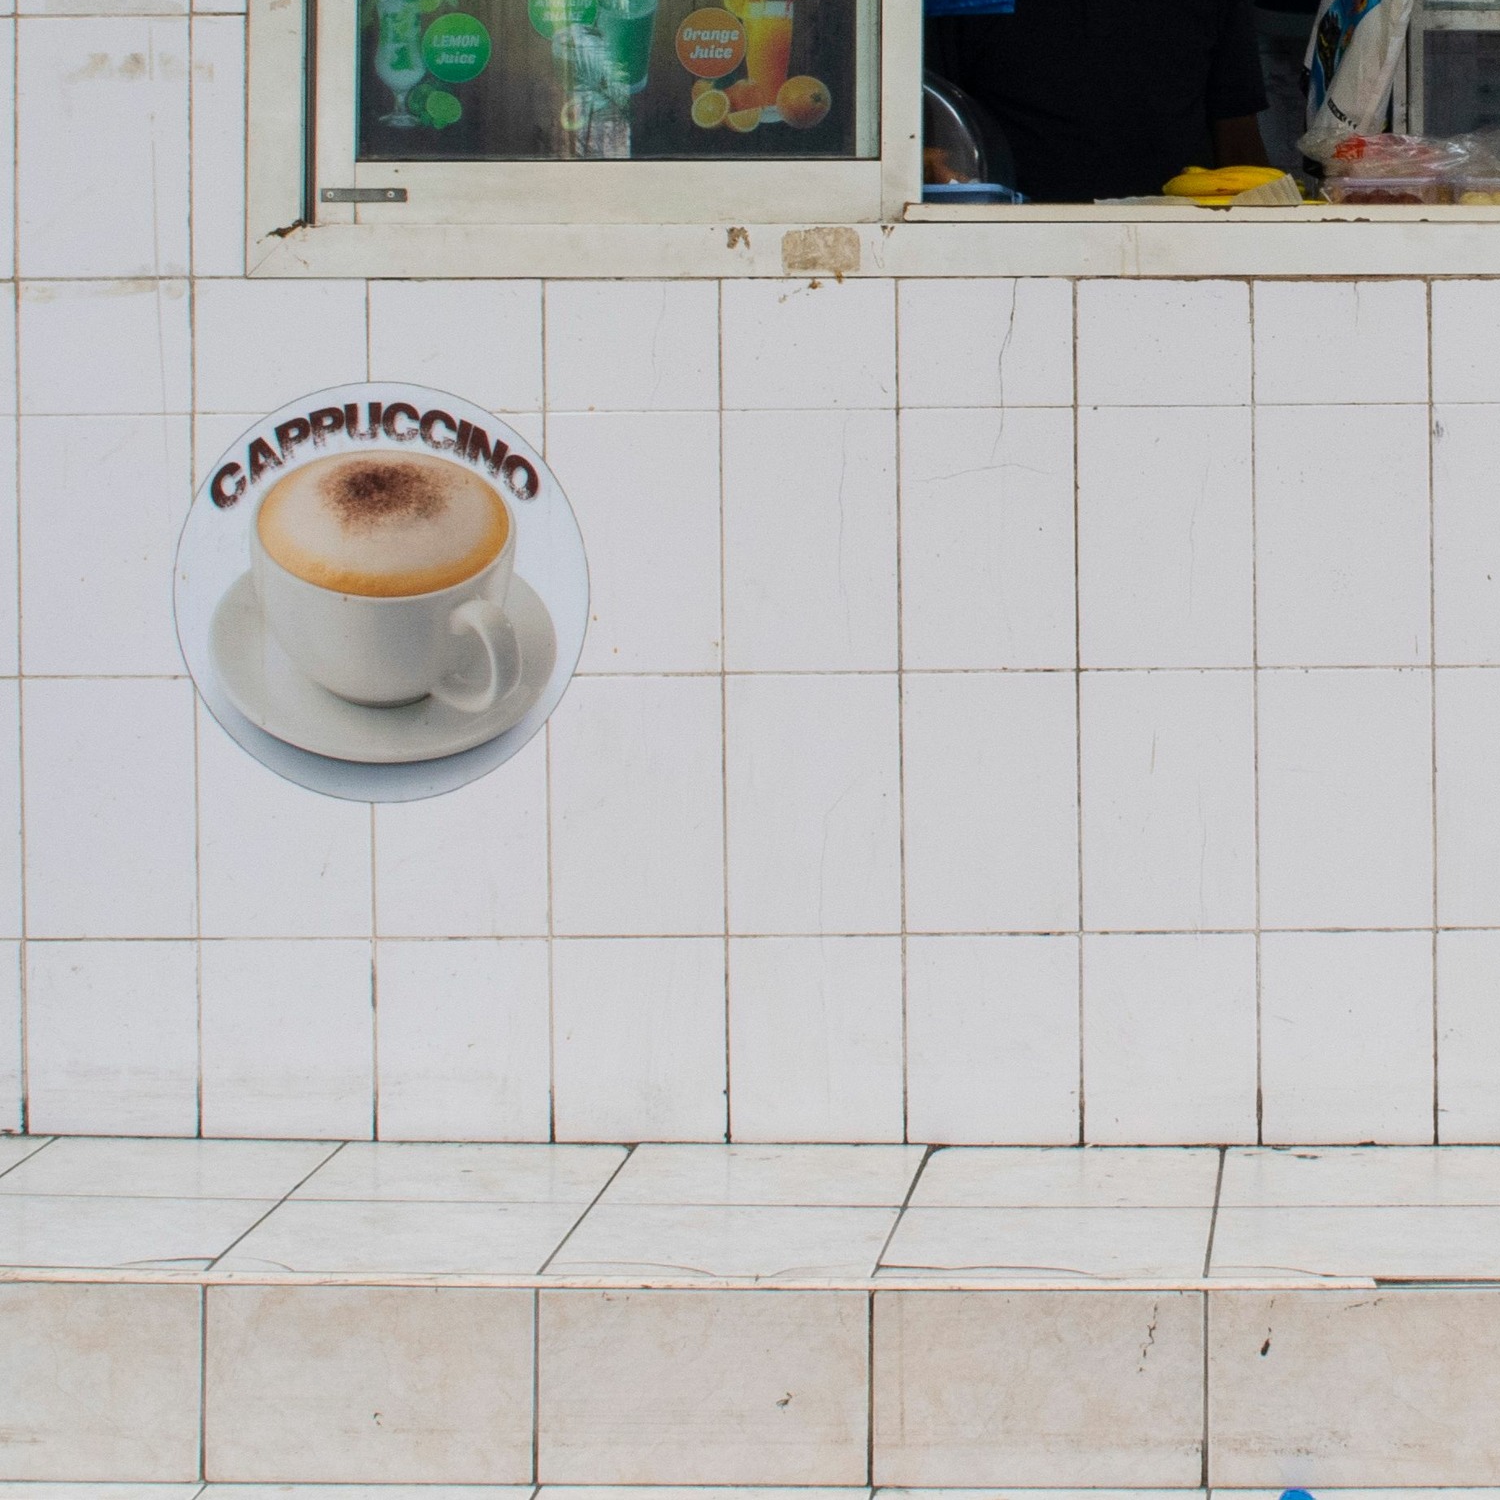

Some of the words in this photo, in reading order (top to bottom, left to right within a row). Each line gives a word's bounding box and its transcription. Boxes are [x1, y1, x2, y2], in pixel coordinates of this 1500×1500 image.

[431, 34, 481, 48] LEMON
[681, 27, 740, 43] Orange
[434, 51, 477, 66] Juice
[688, 45, 734, 60] Juice
[210, 401, 541, 511] CAPPUCCINO
